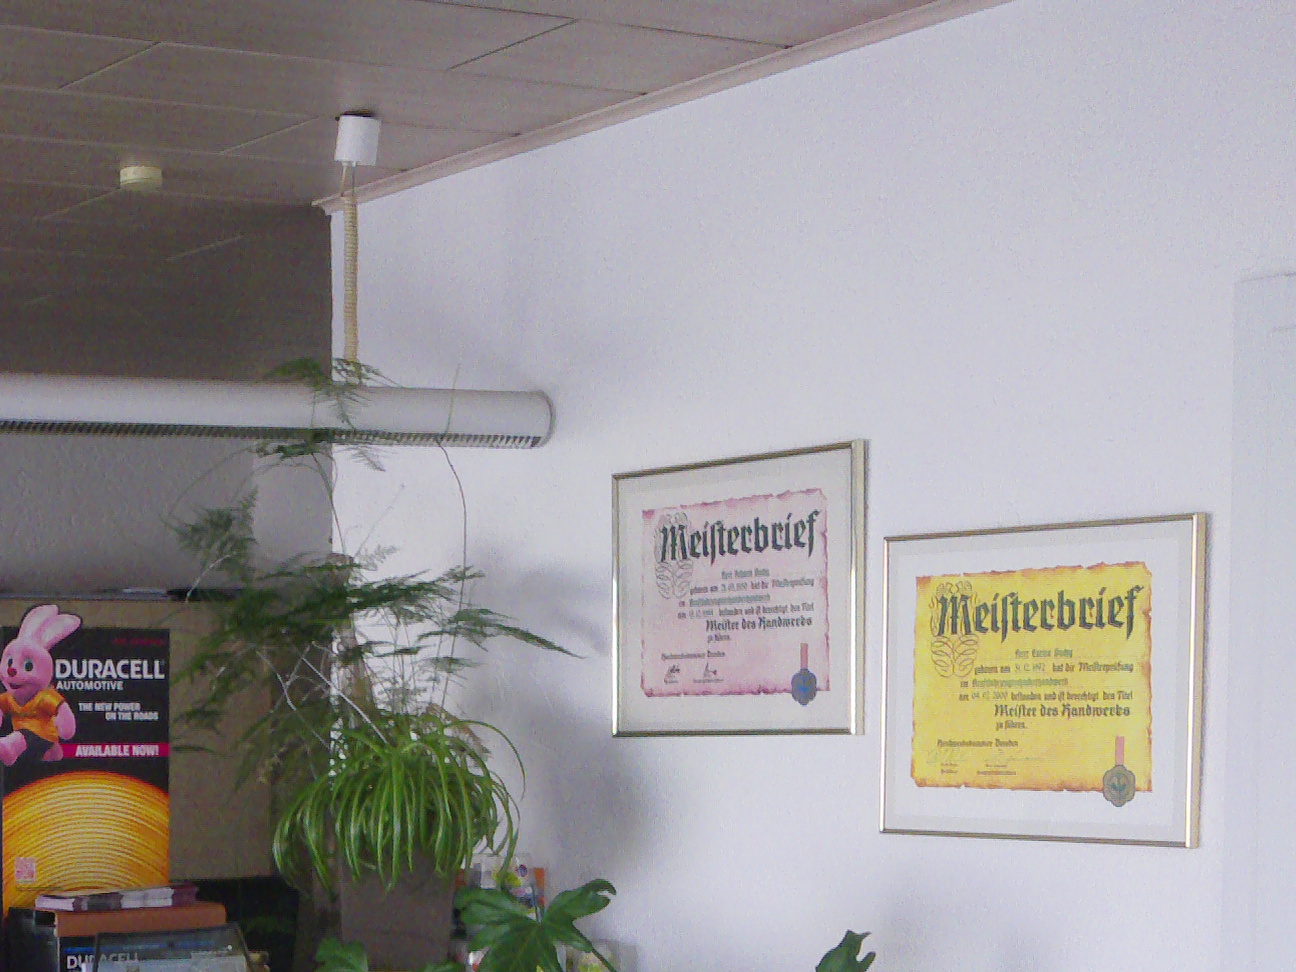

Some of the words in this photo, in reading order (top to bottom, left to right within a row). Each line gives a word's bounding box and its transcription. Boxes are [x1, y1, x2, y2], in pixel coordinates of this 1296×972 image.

[55, 659, 165, 680] DURACELL
[56, 681, 123, 691] AUTOMOTIVE
[78, 702, 93, 711] THE
[94, 702, 112, 711] NEW
[113, 702, 141, 711] POWER
[994, 704, 1037, 718] Meister
[1039, 704, 1058, 717] des
[1062, 703, 1131, 719] Handwerks
[105, 711, 116, 720] ON
[118, 711, 132, 720] THE
[75, 744, 130, 757] AVAILABLE
[132, 744, 160, 757] NOW!
